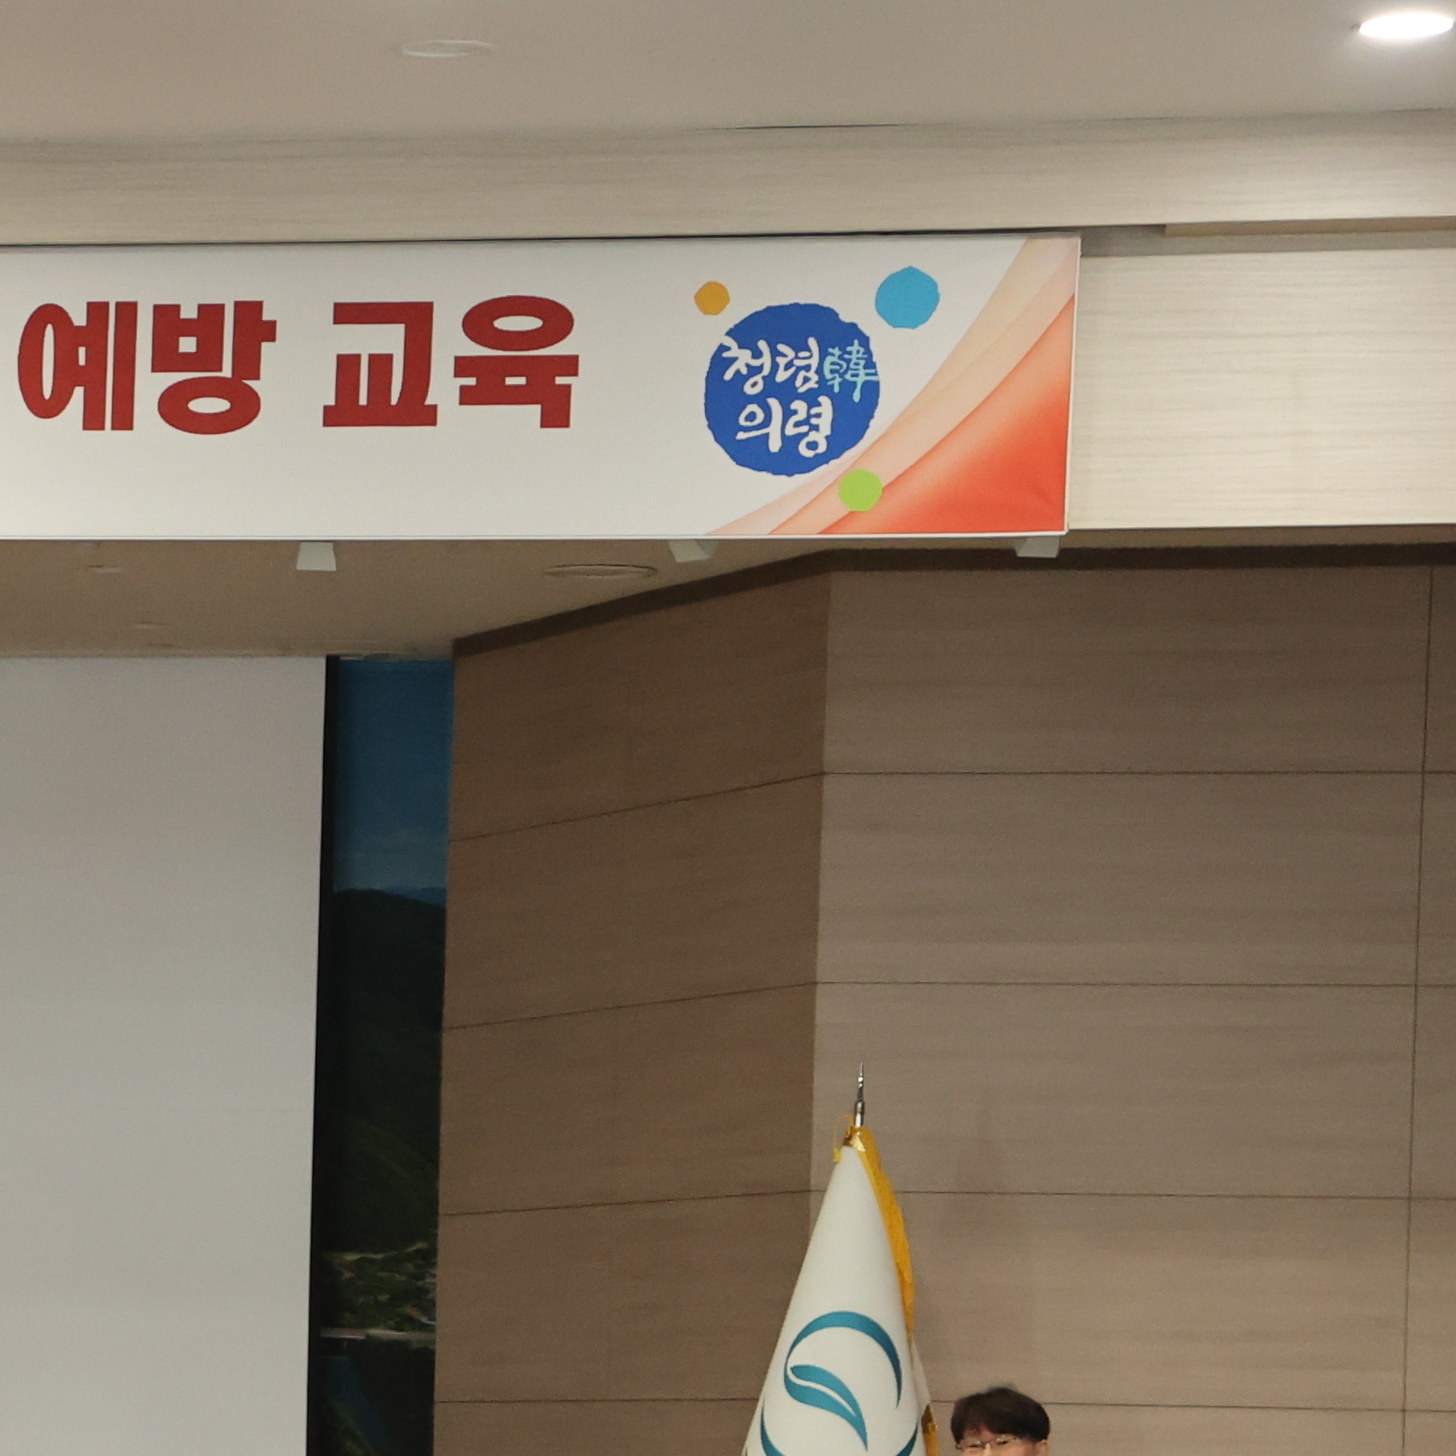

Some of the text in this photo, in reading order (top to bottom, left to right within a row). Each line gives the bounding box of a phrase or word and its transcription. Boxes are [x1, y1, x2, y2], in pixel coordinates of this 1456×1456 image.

[17, 300, 278, 436] 예방
[322, 294, 580, 429] 교육
[735, 395, 834, 458] 의령
